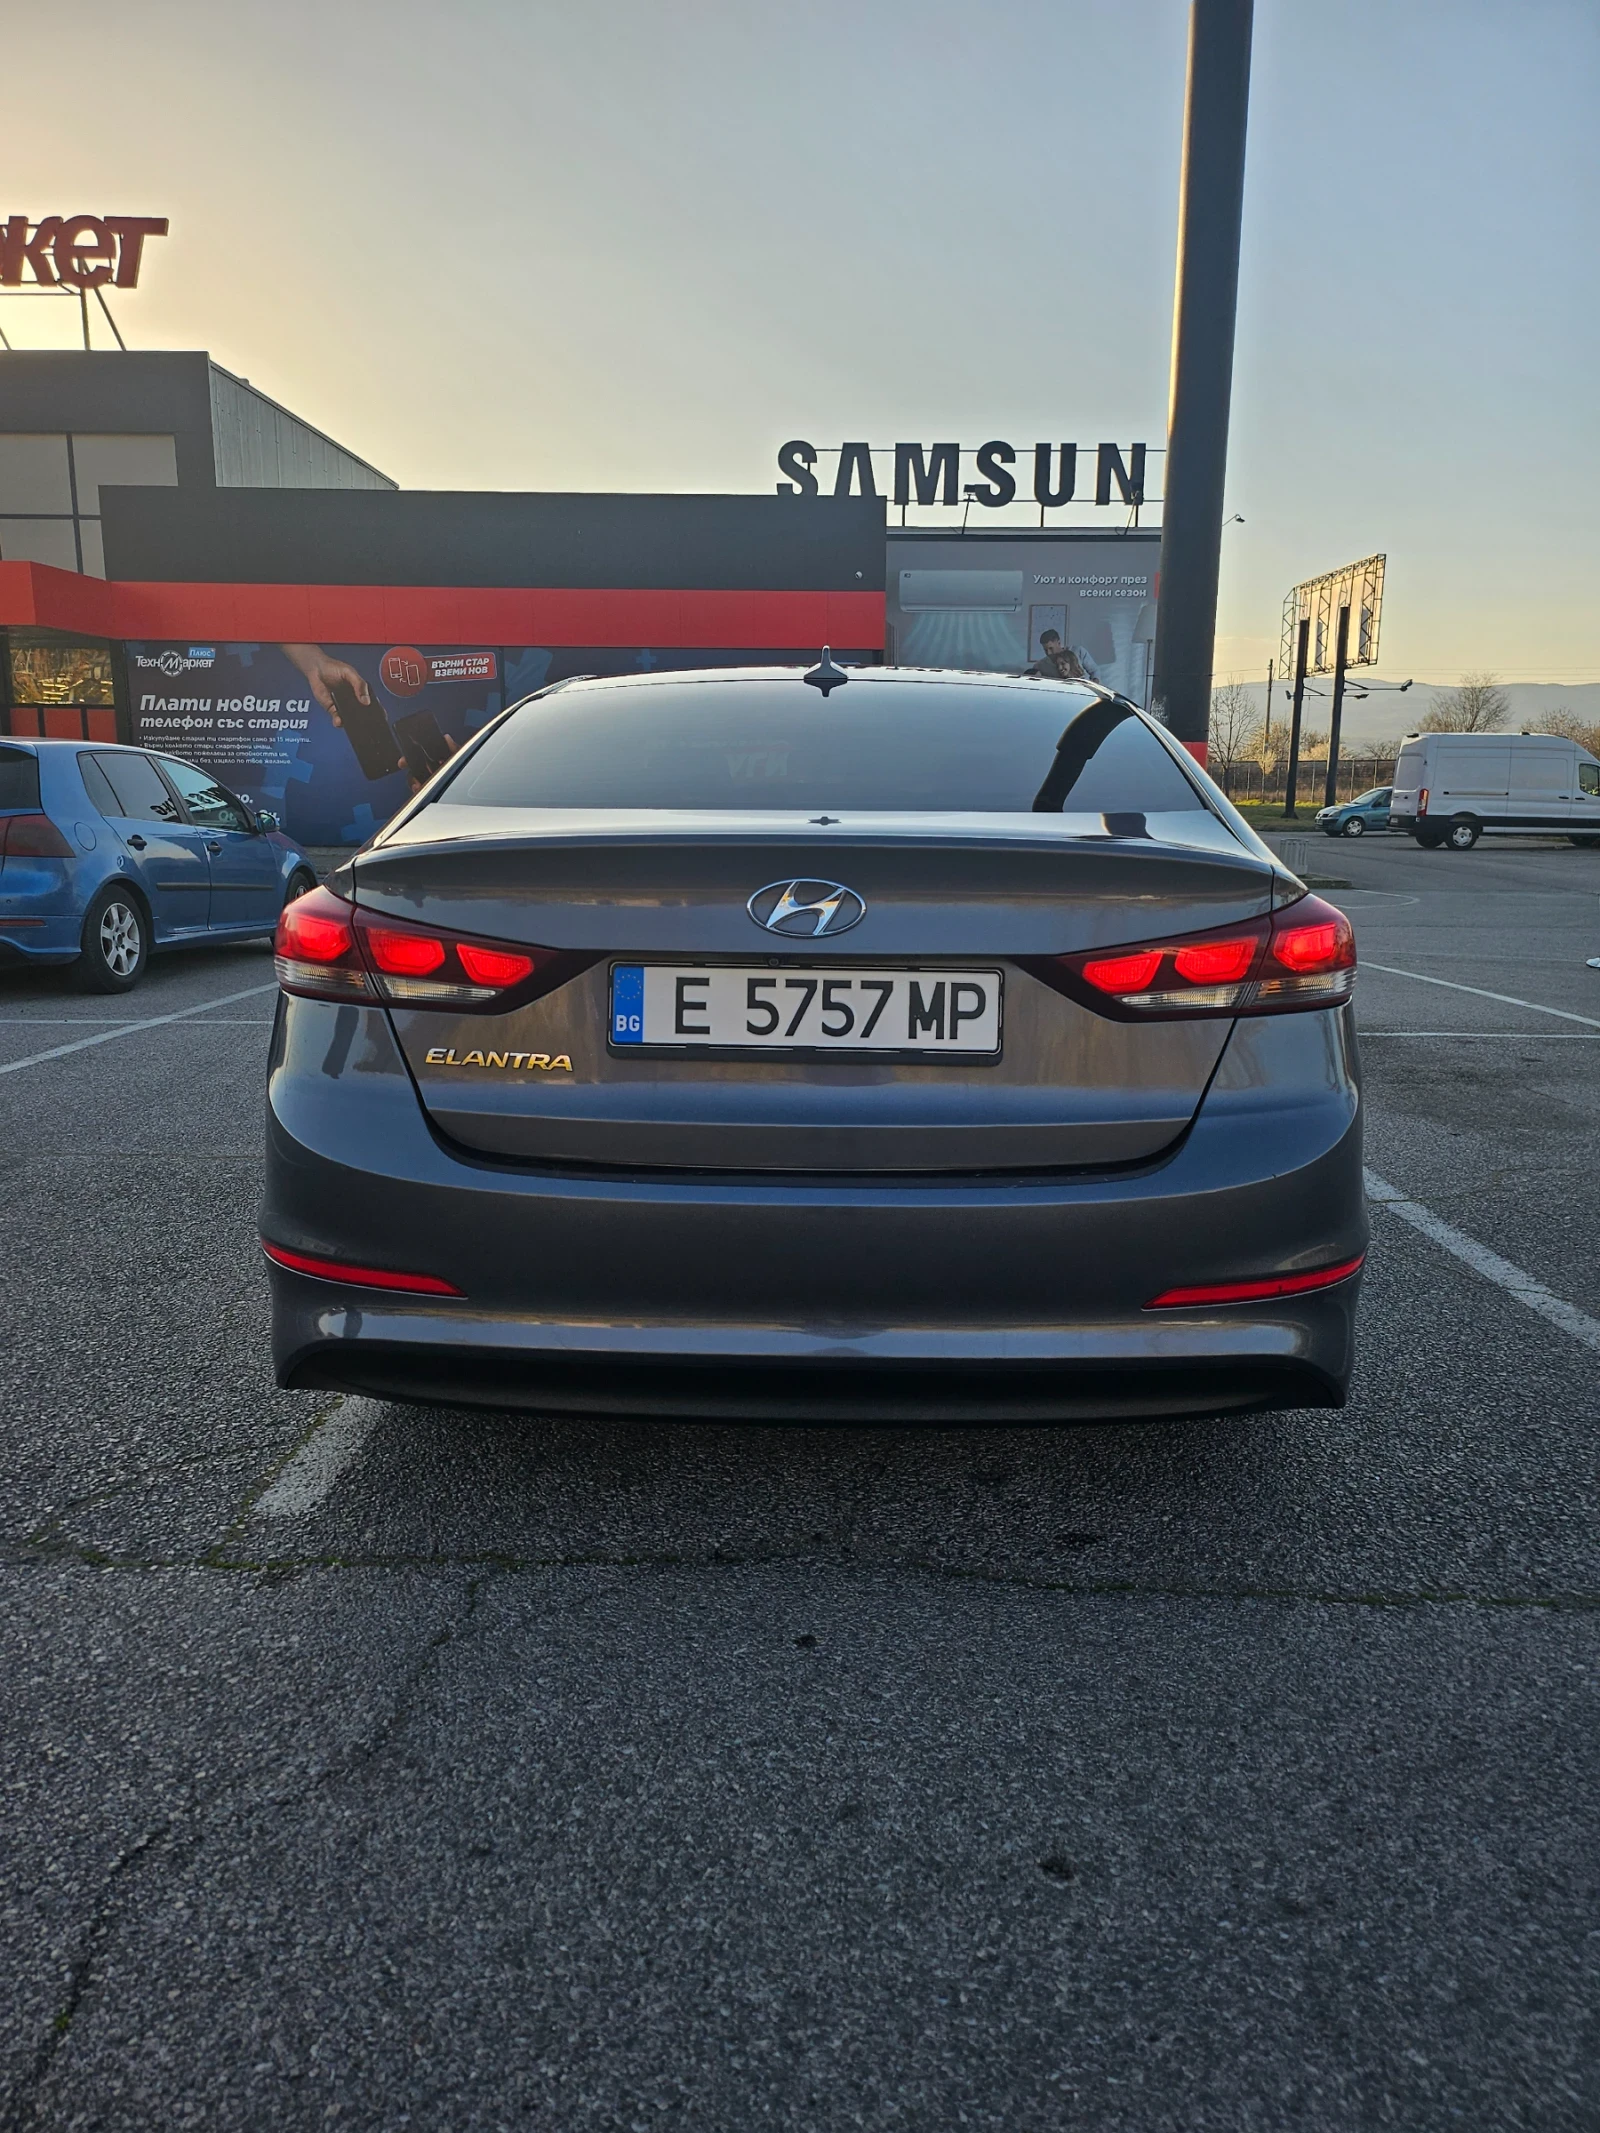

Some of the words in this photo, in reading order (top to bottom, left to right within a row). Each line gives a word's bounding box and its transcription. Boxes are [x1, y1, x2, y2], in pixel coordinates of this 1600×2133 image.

[1033, 574, 1056, 585] Уют
[1058, 575, 1066, 584] и
[1067, 574, 1119, 586] комфорт
[1120, 575, 1148, 585] през
[1079, 588, 1112, 597] всеки
[1114, 588, 1148, 597] сезон
[431, 659, 464, 668] ВЪРНИ
[465, 658, 490, 666] СТАР
[434, 667, 467, 677] ВЗЕМИ
[468, 666, 488, 674] НОВ
[140, 694, 211, 712] Плати
[216, 695, 280, 713] новия
[285, 699, 310, 713] си
[140, 715, 213, 730] телефон
[217, 717, 245, 729] със
[247, 718, 308, 731] стария
[675, 976, 711, 1035] E
[746, 977, 894, 1039] 5757
[908, 980, 987, 1040] MP
[615, 1014, 641, 1033] BG
[425, 1047, 573, 1072] ELANTRA
